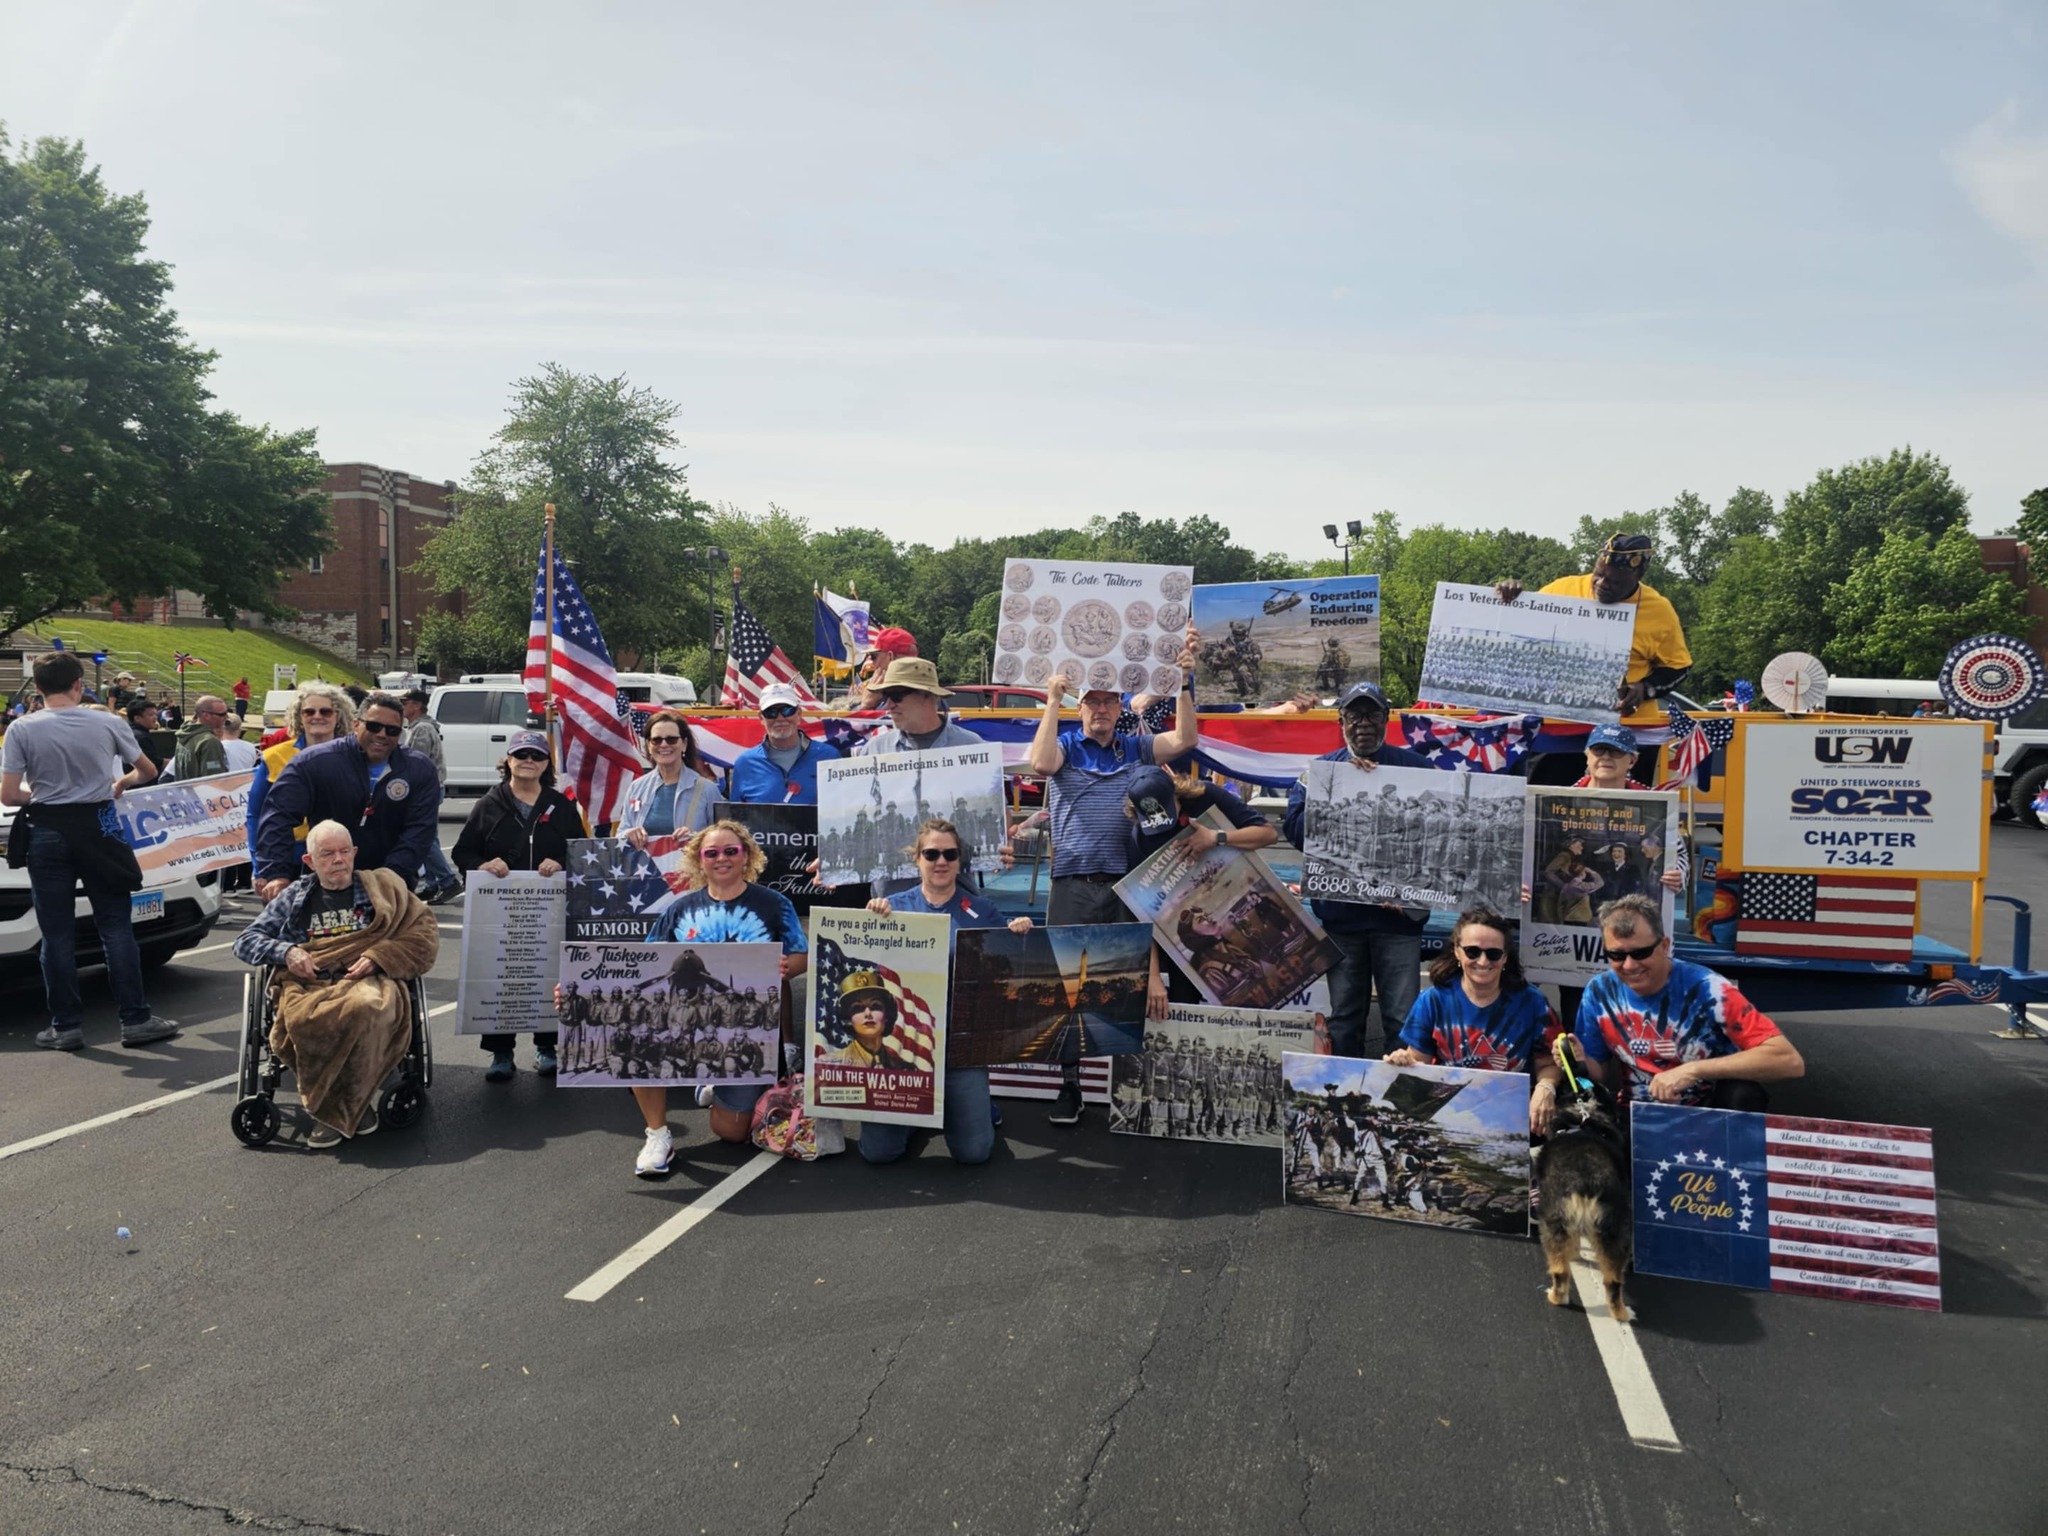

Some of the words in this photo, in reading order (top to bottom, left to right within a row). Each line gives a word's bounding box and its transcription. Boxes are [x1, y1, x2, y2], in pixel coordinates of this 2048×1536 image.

[1049, 571, 1067, 584] The
[1072, 572, 1099, 585] Code
[1104, 573, 1143, 587] Talkers
[1310, 590, 1377, 603] Operation
[1444, 589, 1464, 600] Los
[1578, 606, 1590, 617] in
[1594, 607, 1630, 622] WWII
[1310, 603, 1374, 614] Enduring
[1310, 616, 1368, 627] Freedom
[1815, 736, 1913, 764] USW
[942, 757, 954, 767] in
[958, 752, 990, 766] WWII
[1841, 779, 1921, 787] STEELWORKERS
[161, 800, 205, 820] LEWIS
[206, 798, 216, 812] &
[1791, 787, 1933, 816] SOAR
[1552, 803, 1567, 815] It's
[1580, 806, 1609, 819] grand
[1613, 808, 1633, 819] and
[1562, 819, 1605, 832] glorious
[1608, 820, 1646, 835] feeling
[1804, 831, 1916, 847] CHAPTER
[168, 847, 216, 868] www.lc.edu
[789, 852, 811, 870] th
[1140, 840, 1182, 889] WARTIM
[1825, 850, 1894, 866] 7-34-2
[1305, 861, 1326, 875] the
[1307, 875, 1350, 894] 6888
[1356, 880, 1397, 898] Postal
[1401, 886, 1458, 905] Battalion
[307, 908, 357, 931] ARM
[577, 921, 650, 936] MEMORI
[821, 916, 835, 927] Are
[838, 920, 852, 931] you
[862, 918, 877, 932] girl
[880, 920, 898, 931] with
[900, 922, 906, 931] a
[843, 933, 903, 950] Star-Spangled
[1532, 932, 1569, 948] Enlist
[1538, 947, 1552, 957] in
[1553, 945, 1571, 955] the
[1573, 934, 1609, 964] WA
[564, 945, 591, 963] The
[581, 963, 641, 981] Airmen
[1165, 1009, 1205, 1023] oldiers
[1265, 1018, 1277, 1028] the
[1275, 1029, 1303, 1040] slavery
[819, 1069, 843, 1082] JOIN
[846, 1070, 864, 1084] THE
[866, 1073, 897, 1091] WAC
[1780, 1131, 1813, 1144] United
[1815, 1133, 1847, 1148] States,
[1848, 1139, 1858, 1148] in
[1861, 1138, 1889, 1151] Order
[1891, 1143, 1901, 1152] to
[1784, 1161, 1827, 1173] establish
[1831, 1163, 1867, 1177] Justice,
[1868, 1170, 1900, 1180] insure
[1678, 1172, 1717, 1193] We
[1696, 1193, 1711, 1203] the
[1785, 1188, 1822, 1199] provide
[1824, 1190, 1839, 1202] for
[1841, 1192, 1856, 1203] the
[1858, 1195, 1901, 1208] Common
[1670, 1194, 1735, 1221] People
[1775, 1214, 1812, 1227] General
[1814, 1219, 1860, 1235] Welfare,
[1861, 1225, 1881, 1235] and
[1777, 1243, 1822, 1254] ourselves
[1824, 1246, 1844, 1257] and
[1846, 1250, 1863, 1259] our
[1799, 1271, 1857, 1286] Constitution
[1859, 1281, 1876, 1290] for
[1877, 1281, 1893, 1291] the
